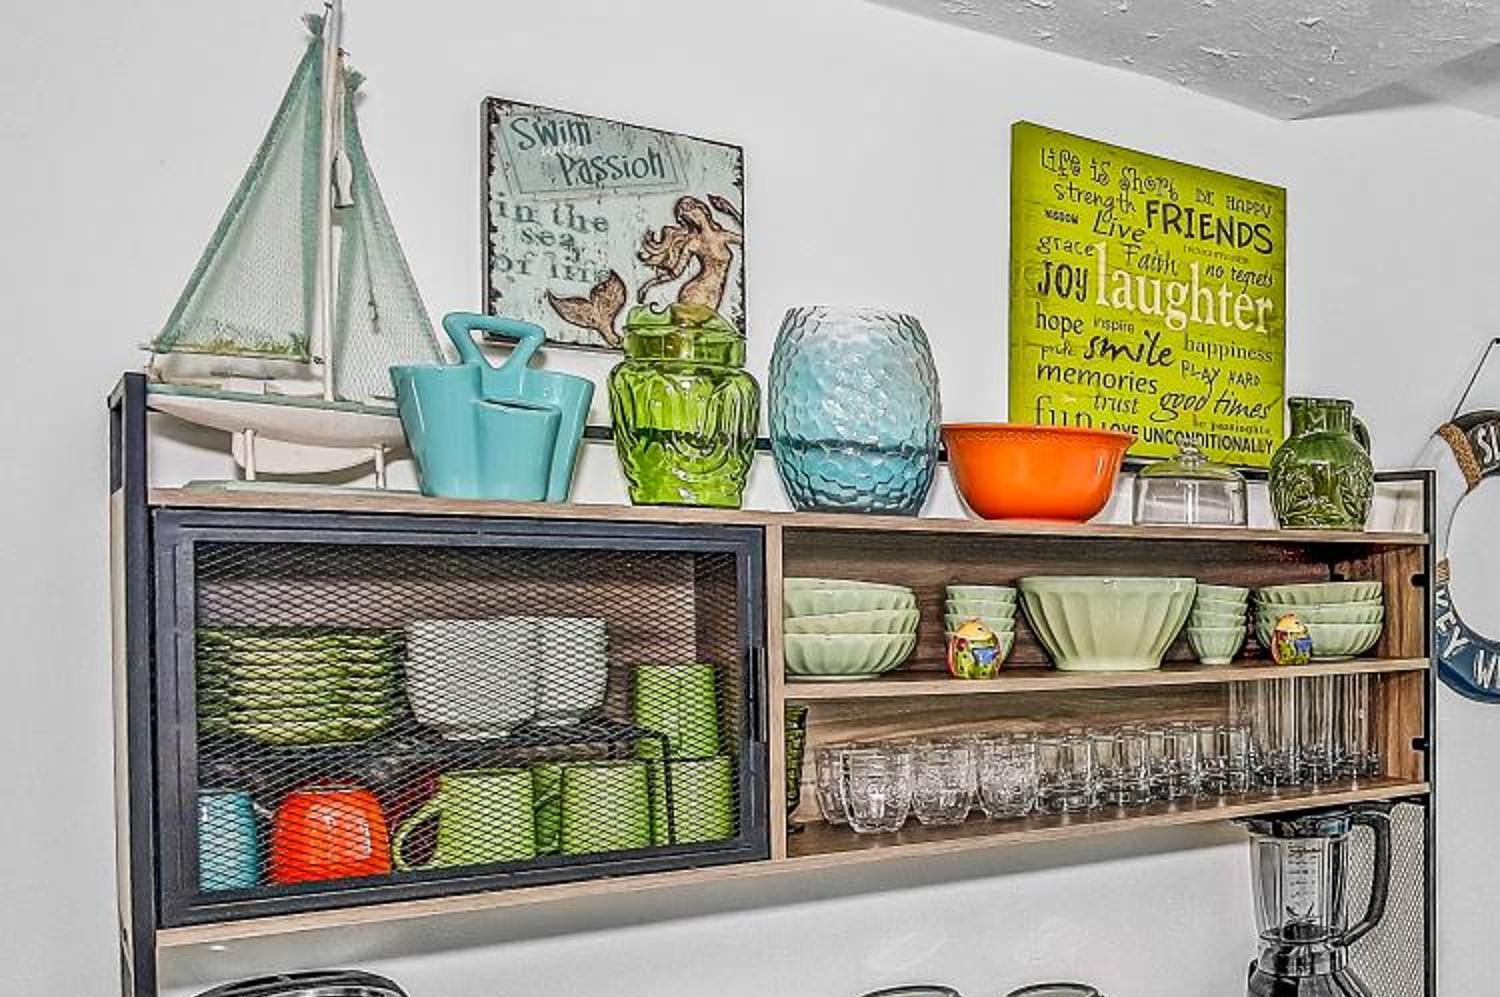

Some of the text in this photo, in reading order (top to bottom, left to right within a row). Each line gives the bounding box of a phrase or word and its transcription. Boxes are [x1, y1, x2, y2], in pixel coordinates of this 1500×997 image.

[510, 117, 592, 150] Swim
[1041, 147, 1081, 179] Life
[552, 202, 609, 233] the
[1226, 195, 1273, 218] HAPPY
[1093, 209, 1146, 242] Live
[1145, 199, 1273, 254] FRIENDS
[1036, 235, 1096, 257] grace
[1094, 239, 1274, 335] laughter
[1035, 301, 1084, 339] hope
[1083, 329, 1176, 368] smile
[1184, 332, 1274, 365] happiness
[1037, 362, 1158, 395] memories
[1094, 395, 1139, 415] trust
[1149, 384, 1212, 422] good
[1212, 387, 1272, 420] times
